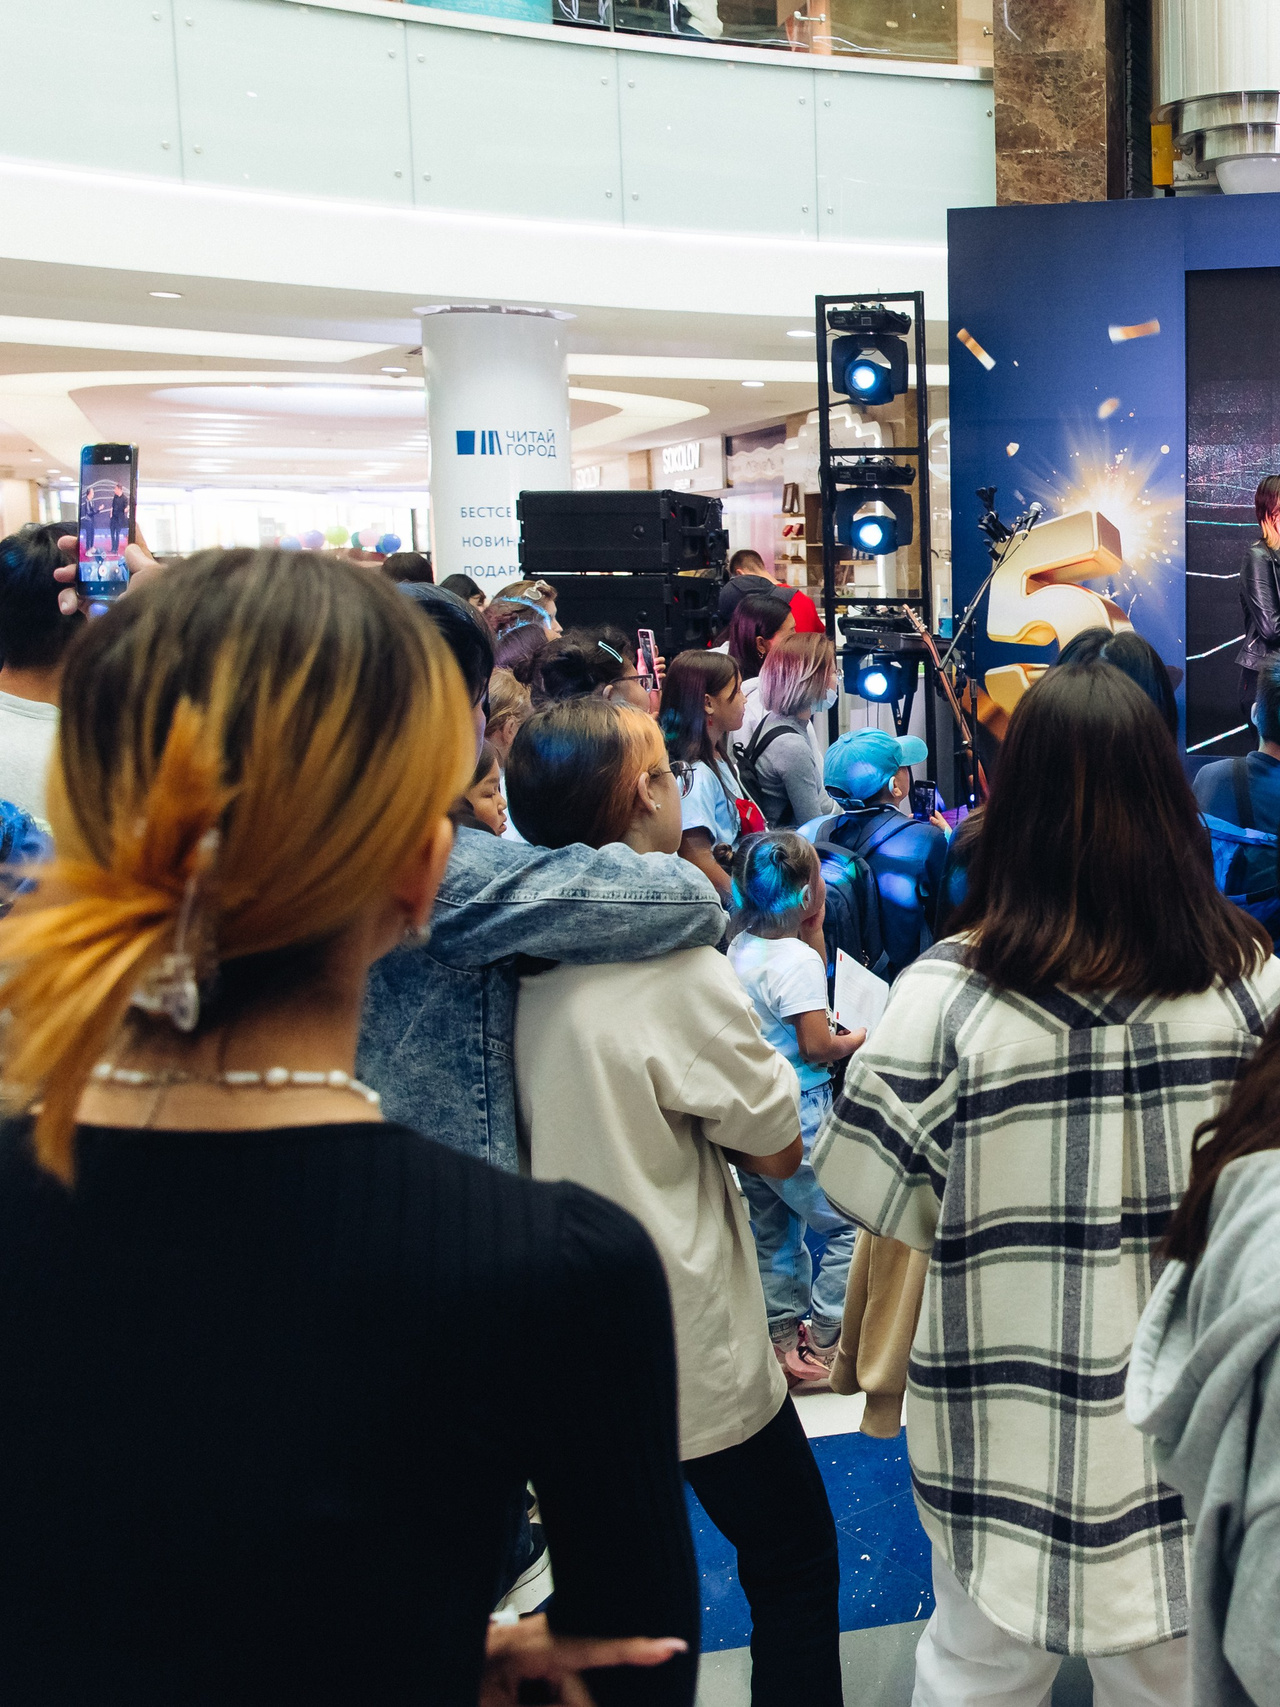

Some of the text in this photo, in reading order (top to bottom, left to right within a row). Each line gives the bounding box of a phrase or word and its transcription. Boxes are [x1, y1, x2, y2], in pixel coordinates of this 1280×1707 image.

[505, 428, 556, 444] ЧИТАЙ
[506, 443, 557, 459] ГОРОД
[662, 442, 701, 475] SOKOLOV
